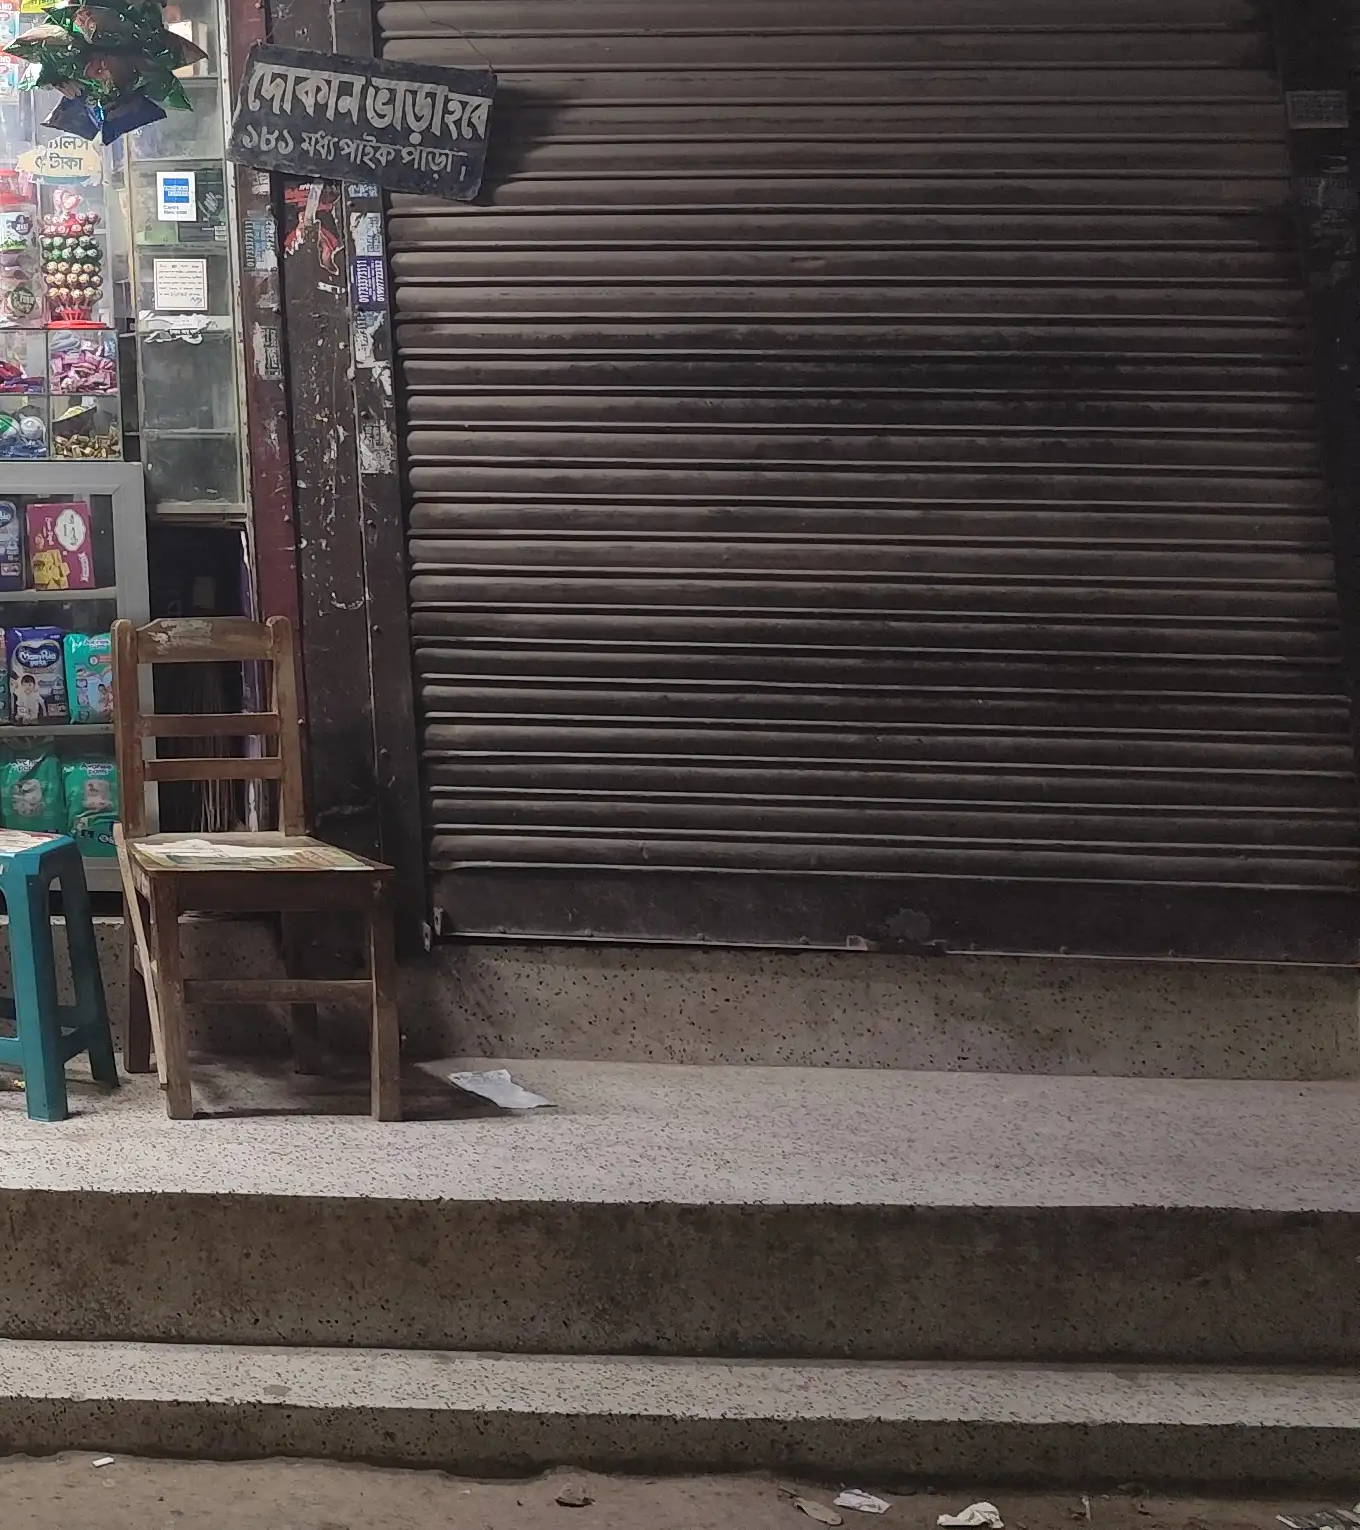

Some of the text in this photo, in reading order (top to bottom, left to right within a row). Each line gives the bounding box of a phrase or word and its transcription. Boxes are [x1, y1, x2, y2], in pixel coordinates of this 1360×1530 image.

[248, 62, 494, 144] দোকান ভাড়া হবে
[242, 125, 295, 155] ১৮১
[300, 130, 338, 161] মধ্য
